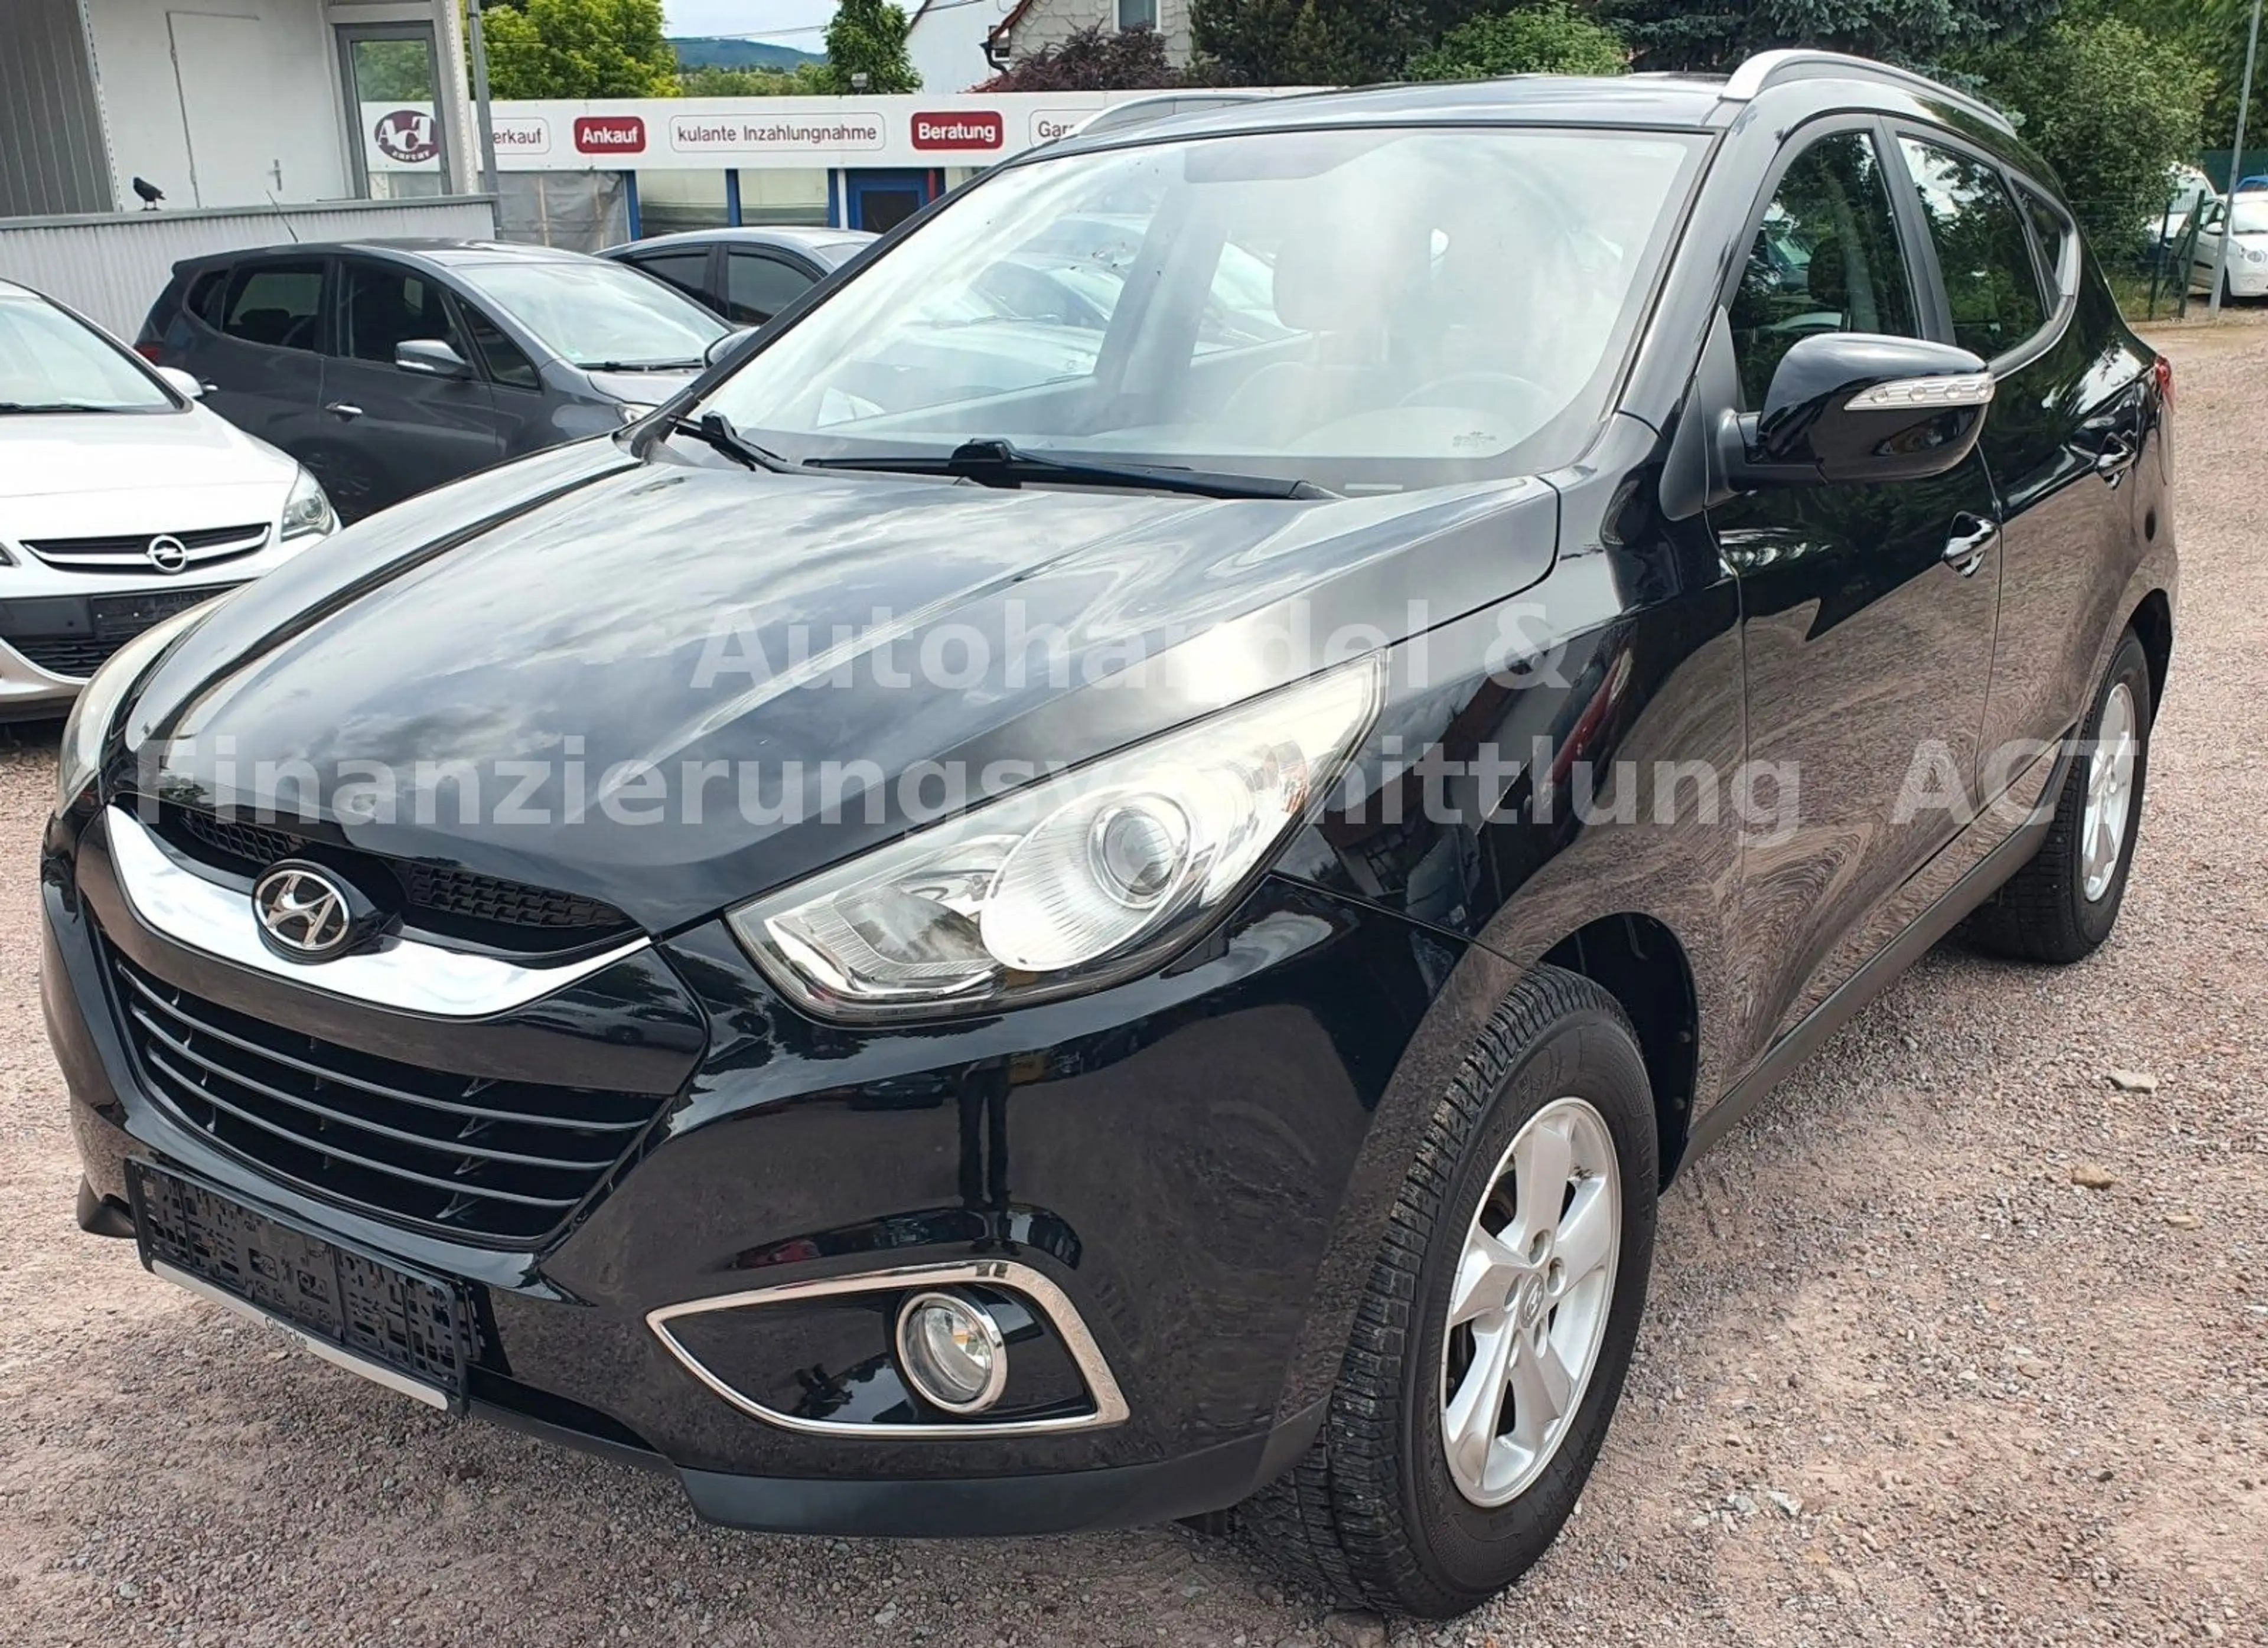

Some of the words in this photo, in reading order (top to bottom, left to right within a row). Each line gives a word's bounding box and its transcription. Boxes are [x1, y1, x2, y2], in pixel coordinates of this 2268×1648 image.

[493, 128, 542, 145] erkauf
[581, 126, 638, 145] Ankauf
[678, 125, 737, 142] kulante
[743, 124, 877, 143] Inzahlungnahme
[918, 122, 996, 142] Beratung
[1038, 120, 1074, 138] Gar
